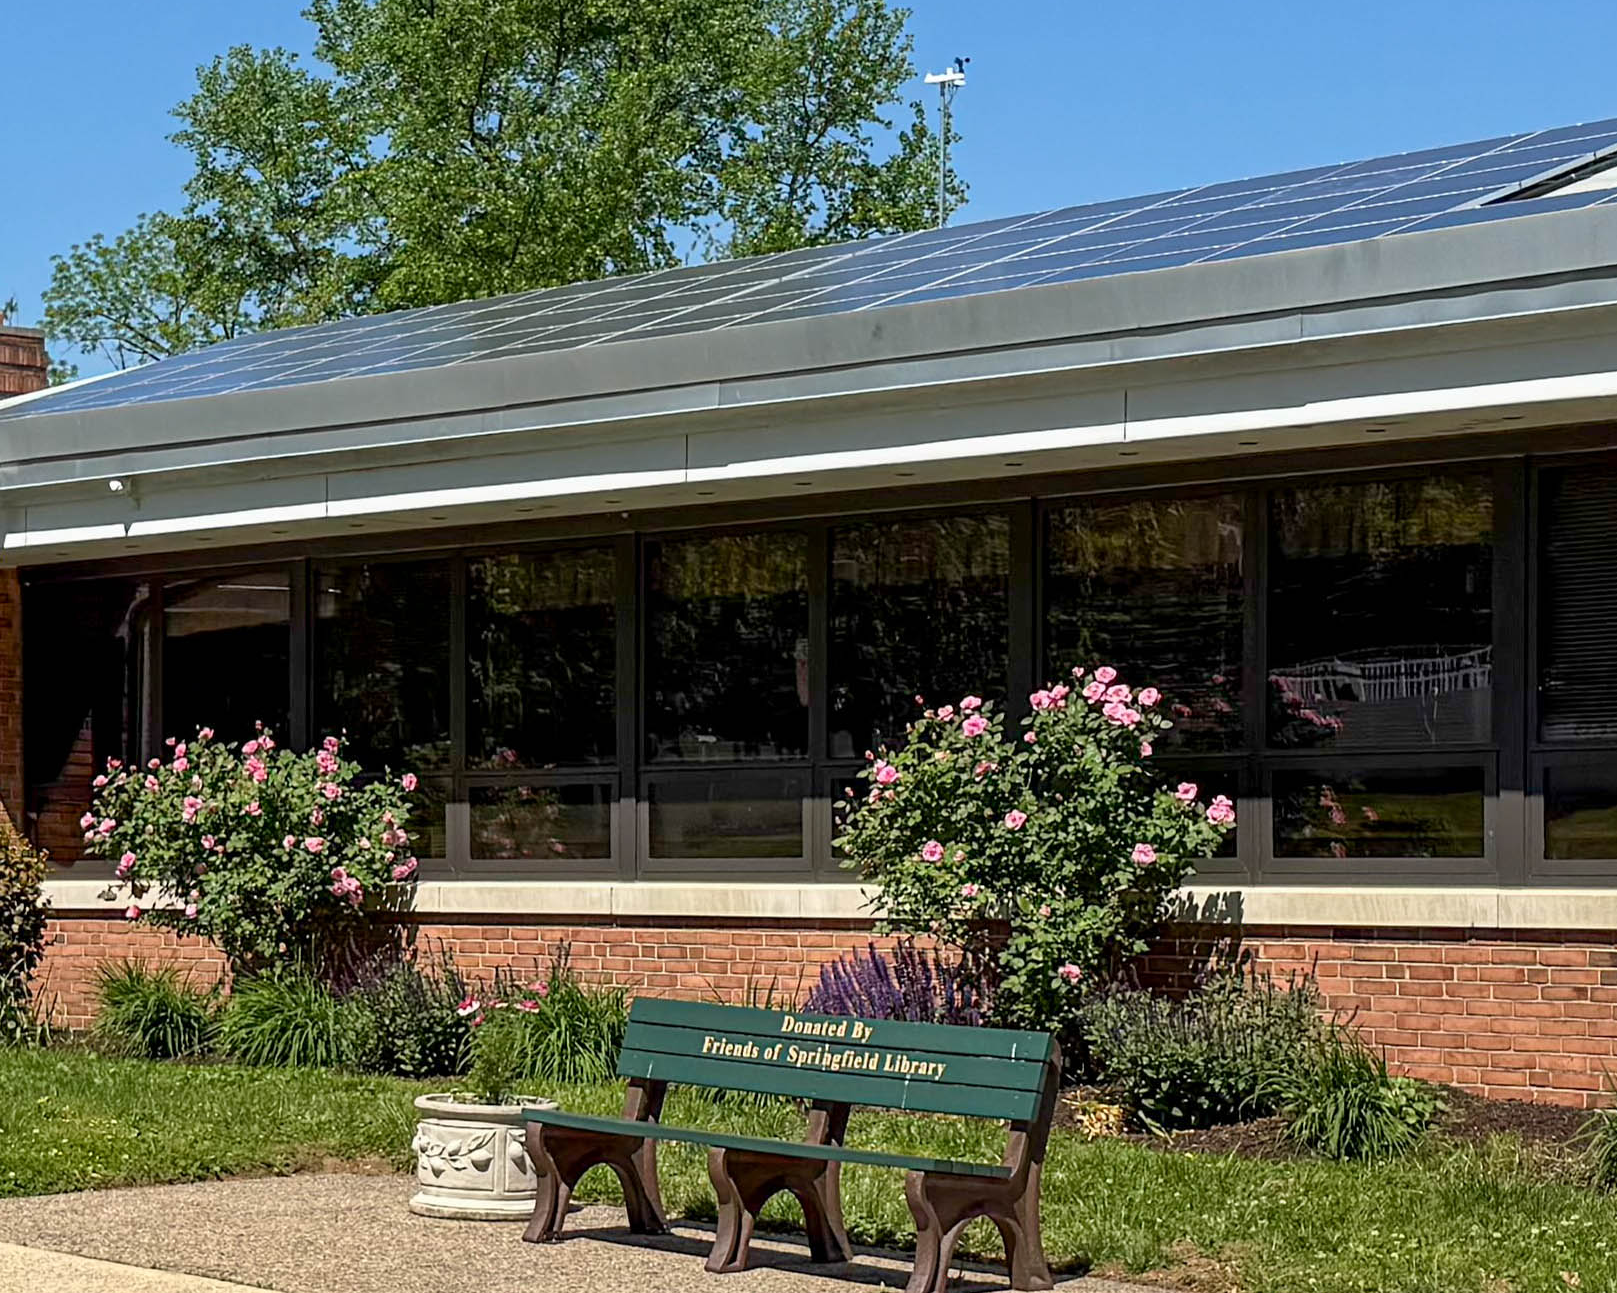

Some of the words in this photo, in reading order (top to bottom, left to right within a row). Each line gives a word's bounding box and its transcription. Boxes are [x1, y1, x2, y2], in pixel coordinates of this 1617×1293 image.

[781, 1015, 847, 1038] Donated
[851, 1020, 873, 1044] By
[702, 1036, 759, 1059] Friends
[764, 1043, 782, 1061] of
[786, 1045, 879, 1072] Springfield
[883, 1053, 946, 1081] Library
